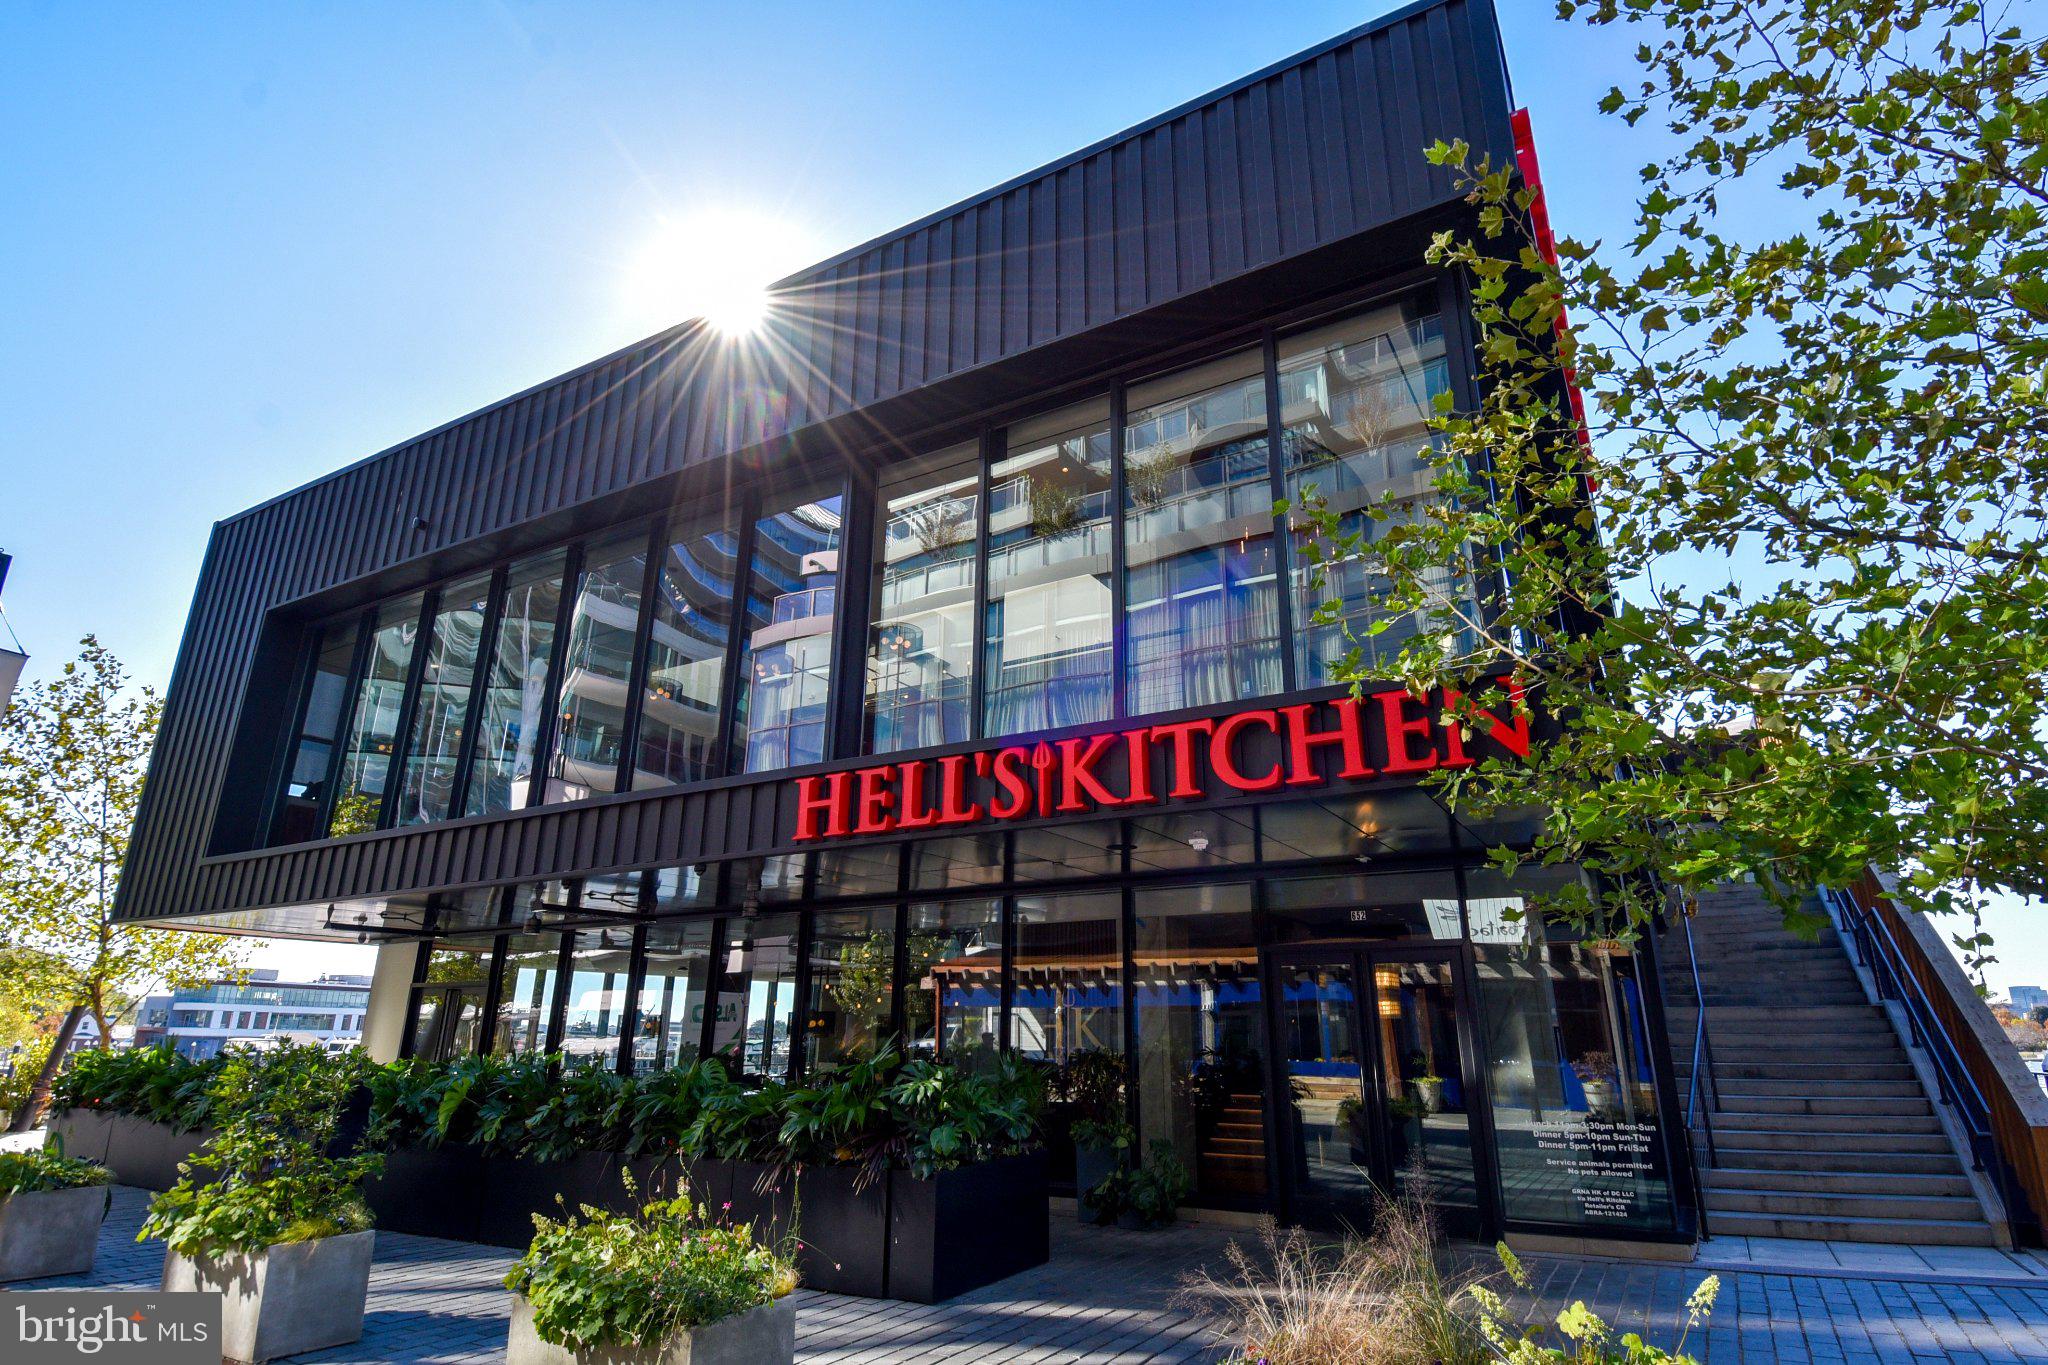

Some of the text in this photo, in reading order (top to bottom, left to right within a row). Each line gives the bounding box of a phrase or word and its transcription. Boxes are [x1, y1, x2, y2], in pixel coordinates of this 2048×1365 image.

[791, 676, 1531, 842] HELL'S KITCHEN
[1616, 1123, 1656, 1132] Mon-Sun
[1533, 1130, 1651, 1142] Dinner 5pm-10pm Sun-Thu
[1538, 1140, 1649, 1152] Dinner 5pm-11pm Fri/Sat
[1546, 1158, 1653, 1170] Service animals permitted
[1567, 1167, 1579, 1175] No
[1601, 1169, 1633, 1178] allowed
